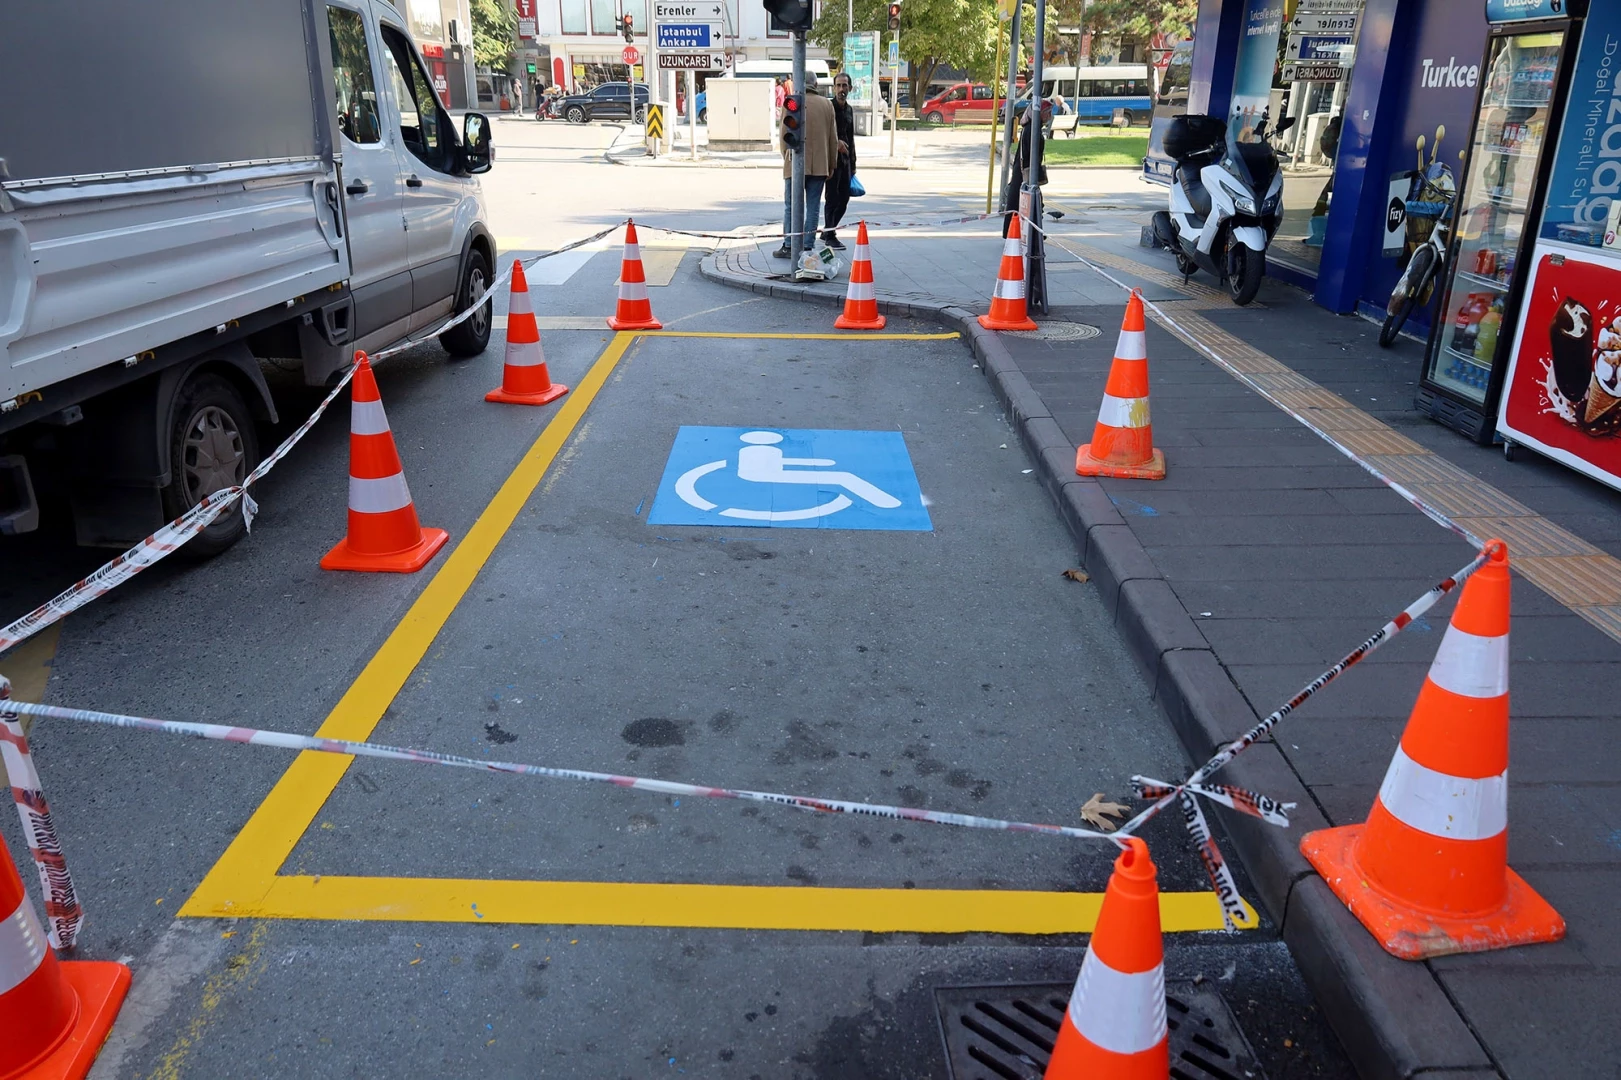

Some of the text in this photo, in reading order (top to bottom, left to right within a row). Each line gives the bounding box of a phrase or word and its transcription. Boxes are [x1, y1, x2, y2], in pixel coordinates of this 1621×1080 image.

[656, 5, 697, 16] Erenler
[660, 25, 702, 36] İstanbul
[660, 38, 697, 47] Ankara
[623, 51, 638, 60] DUR
[660, 55, 710, 68] UZUNÇARŞI
[1595, 33, 1618, 94] Doğal
[1421, 56, 1482, 88] Turkce
[1389, 207, 1404, 223] fizy
